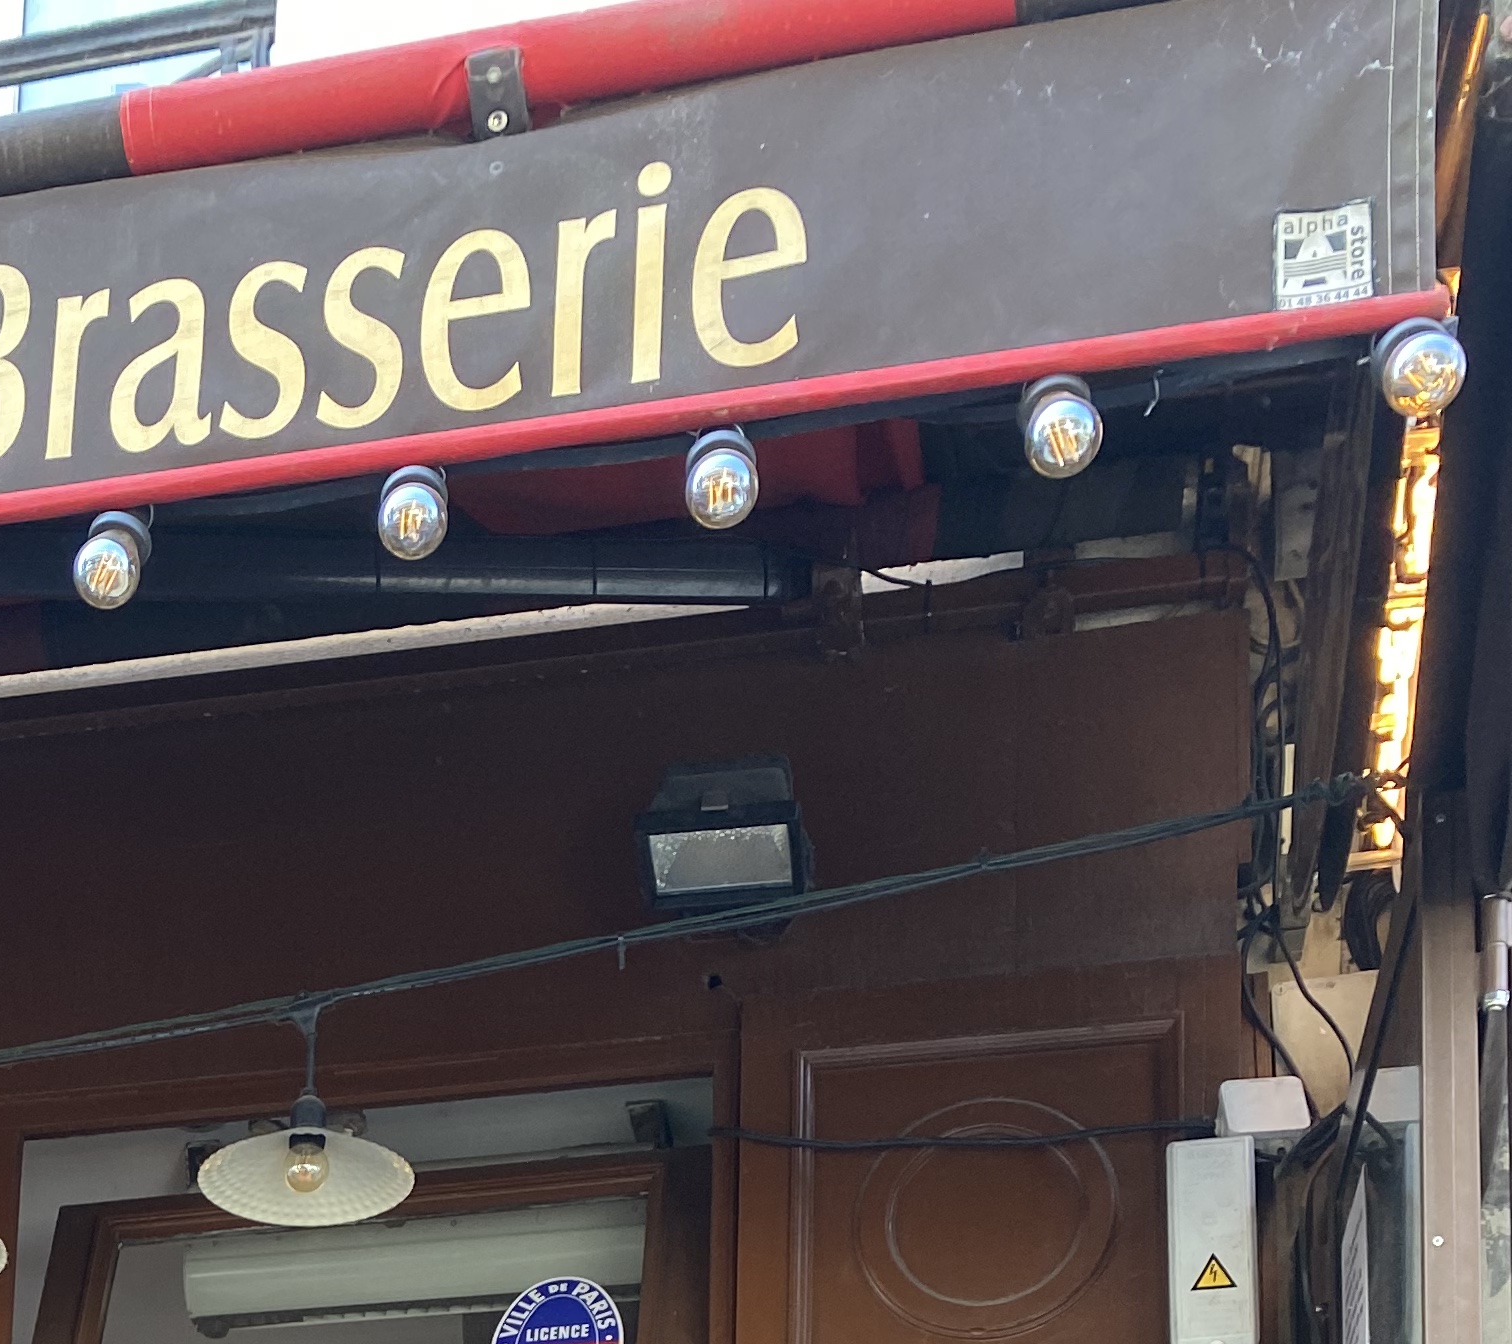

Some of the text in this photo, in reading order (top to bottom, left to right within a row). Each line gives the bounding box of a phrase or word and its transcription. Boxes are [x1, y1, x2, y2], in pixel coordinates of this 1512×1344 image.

[1283, 214, 1348, 237] alpha
[1351, 225, 1369, 281] store
[498, 1282, 617, 1338] VILLE DE PARIS
[525, 1323, 590, 1343] LICENCE
